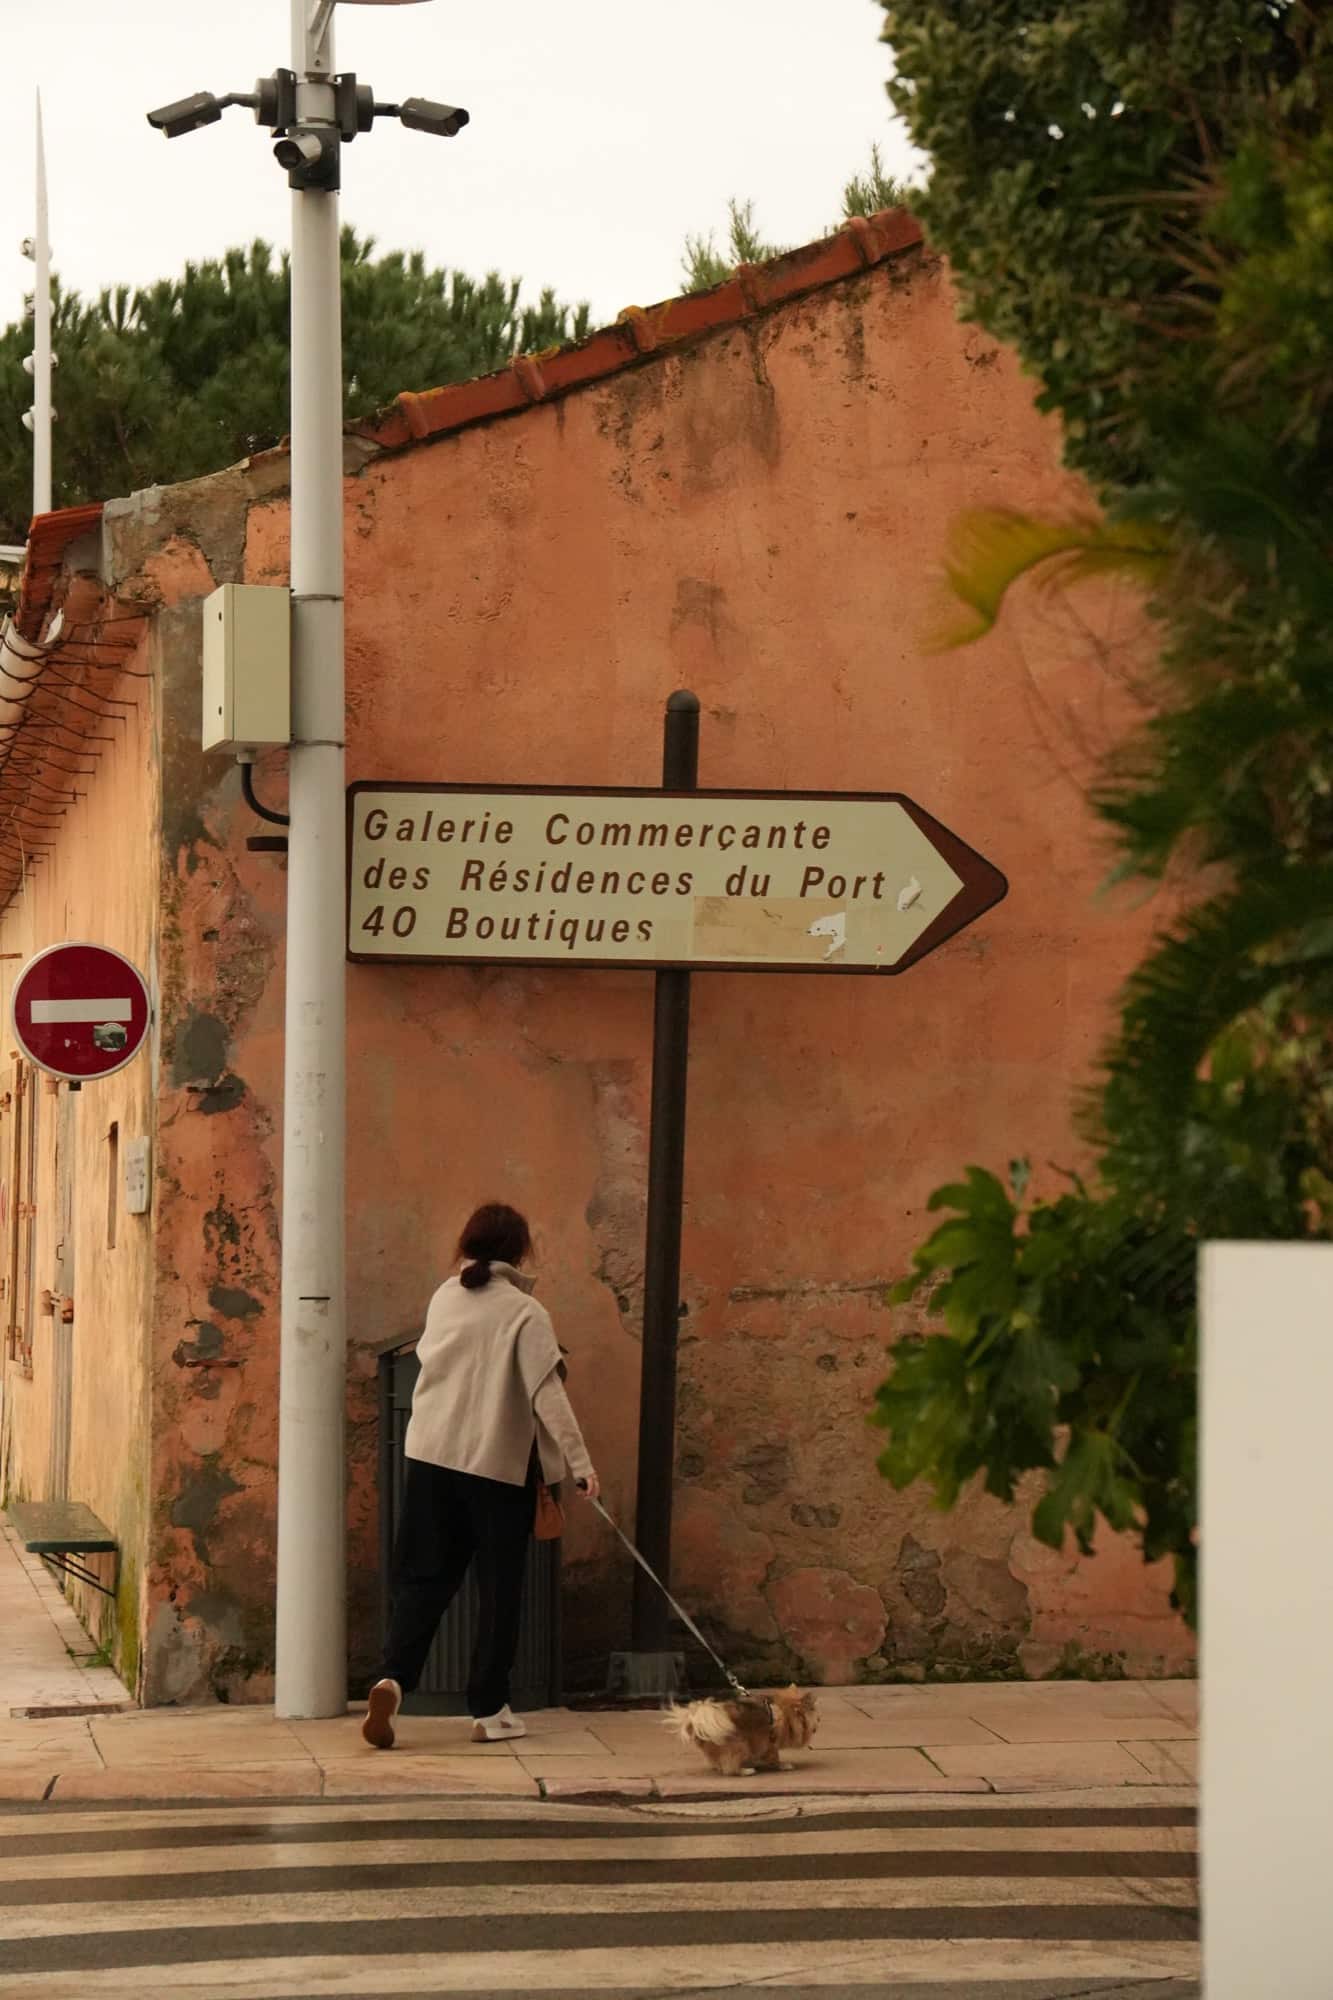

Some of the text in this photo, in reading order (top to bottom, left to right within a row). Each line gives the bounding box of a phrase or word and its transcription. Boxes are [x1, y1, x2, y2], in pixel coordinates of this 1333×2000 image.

[363, 808, 831, 852] Galerie Commerçante
[362, 857, 885, 900] des Résidences du Port
[361, 904, 654, 950] 40 Boutiques
